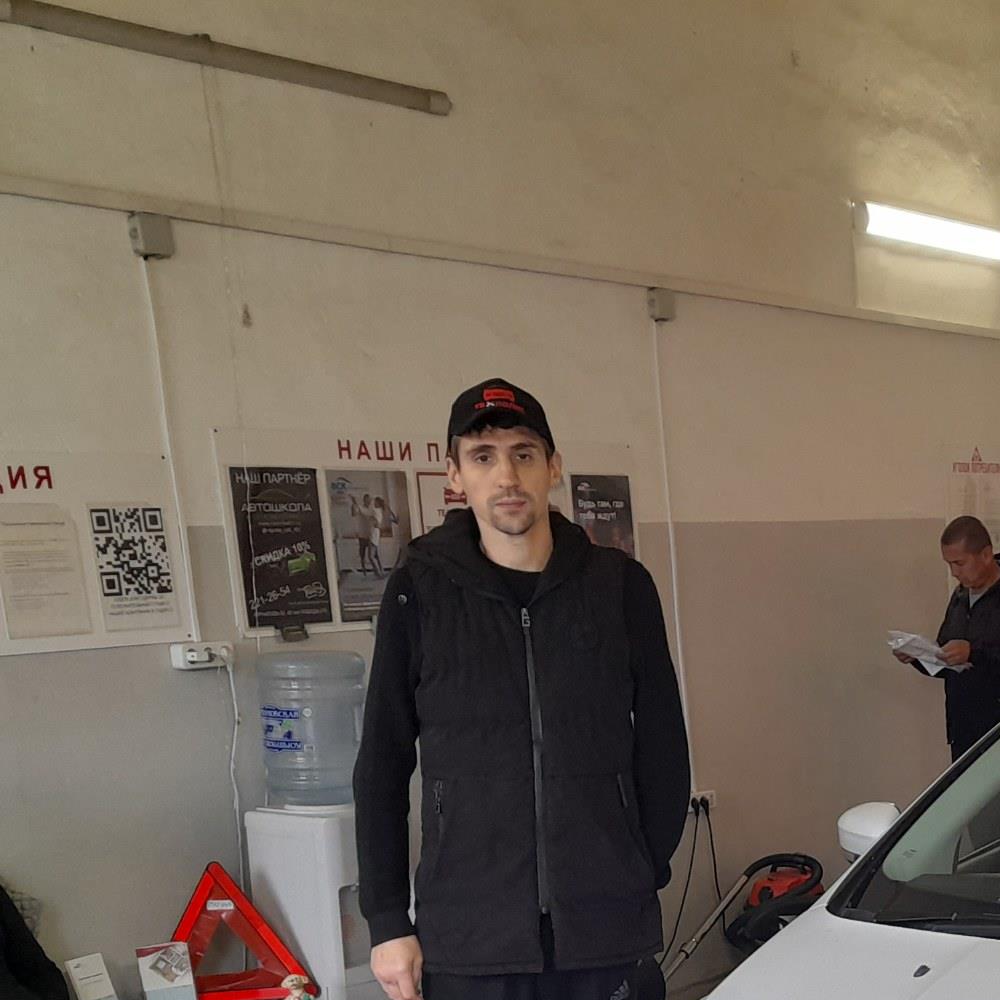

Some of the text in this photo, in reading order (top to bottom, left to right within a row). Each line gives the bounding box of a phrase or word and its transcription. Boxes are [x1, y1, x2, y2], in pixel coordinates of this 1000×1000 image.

[338, 440, 411, 461] НАШИ
[235, 472, 261, 484] НАШ
[241, 502, 313, 513] АВТОШКОЛА
[255, 541, 311, 566] СКИДКА 10%
